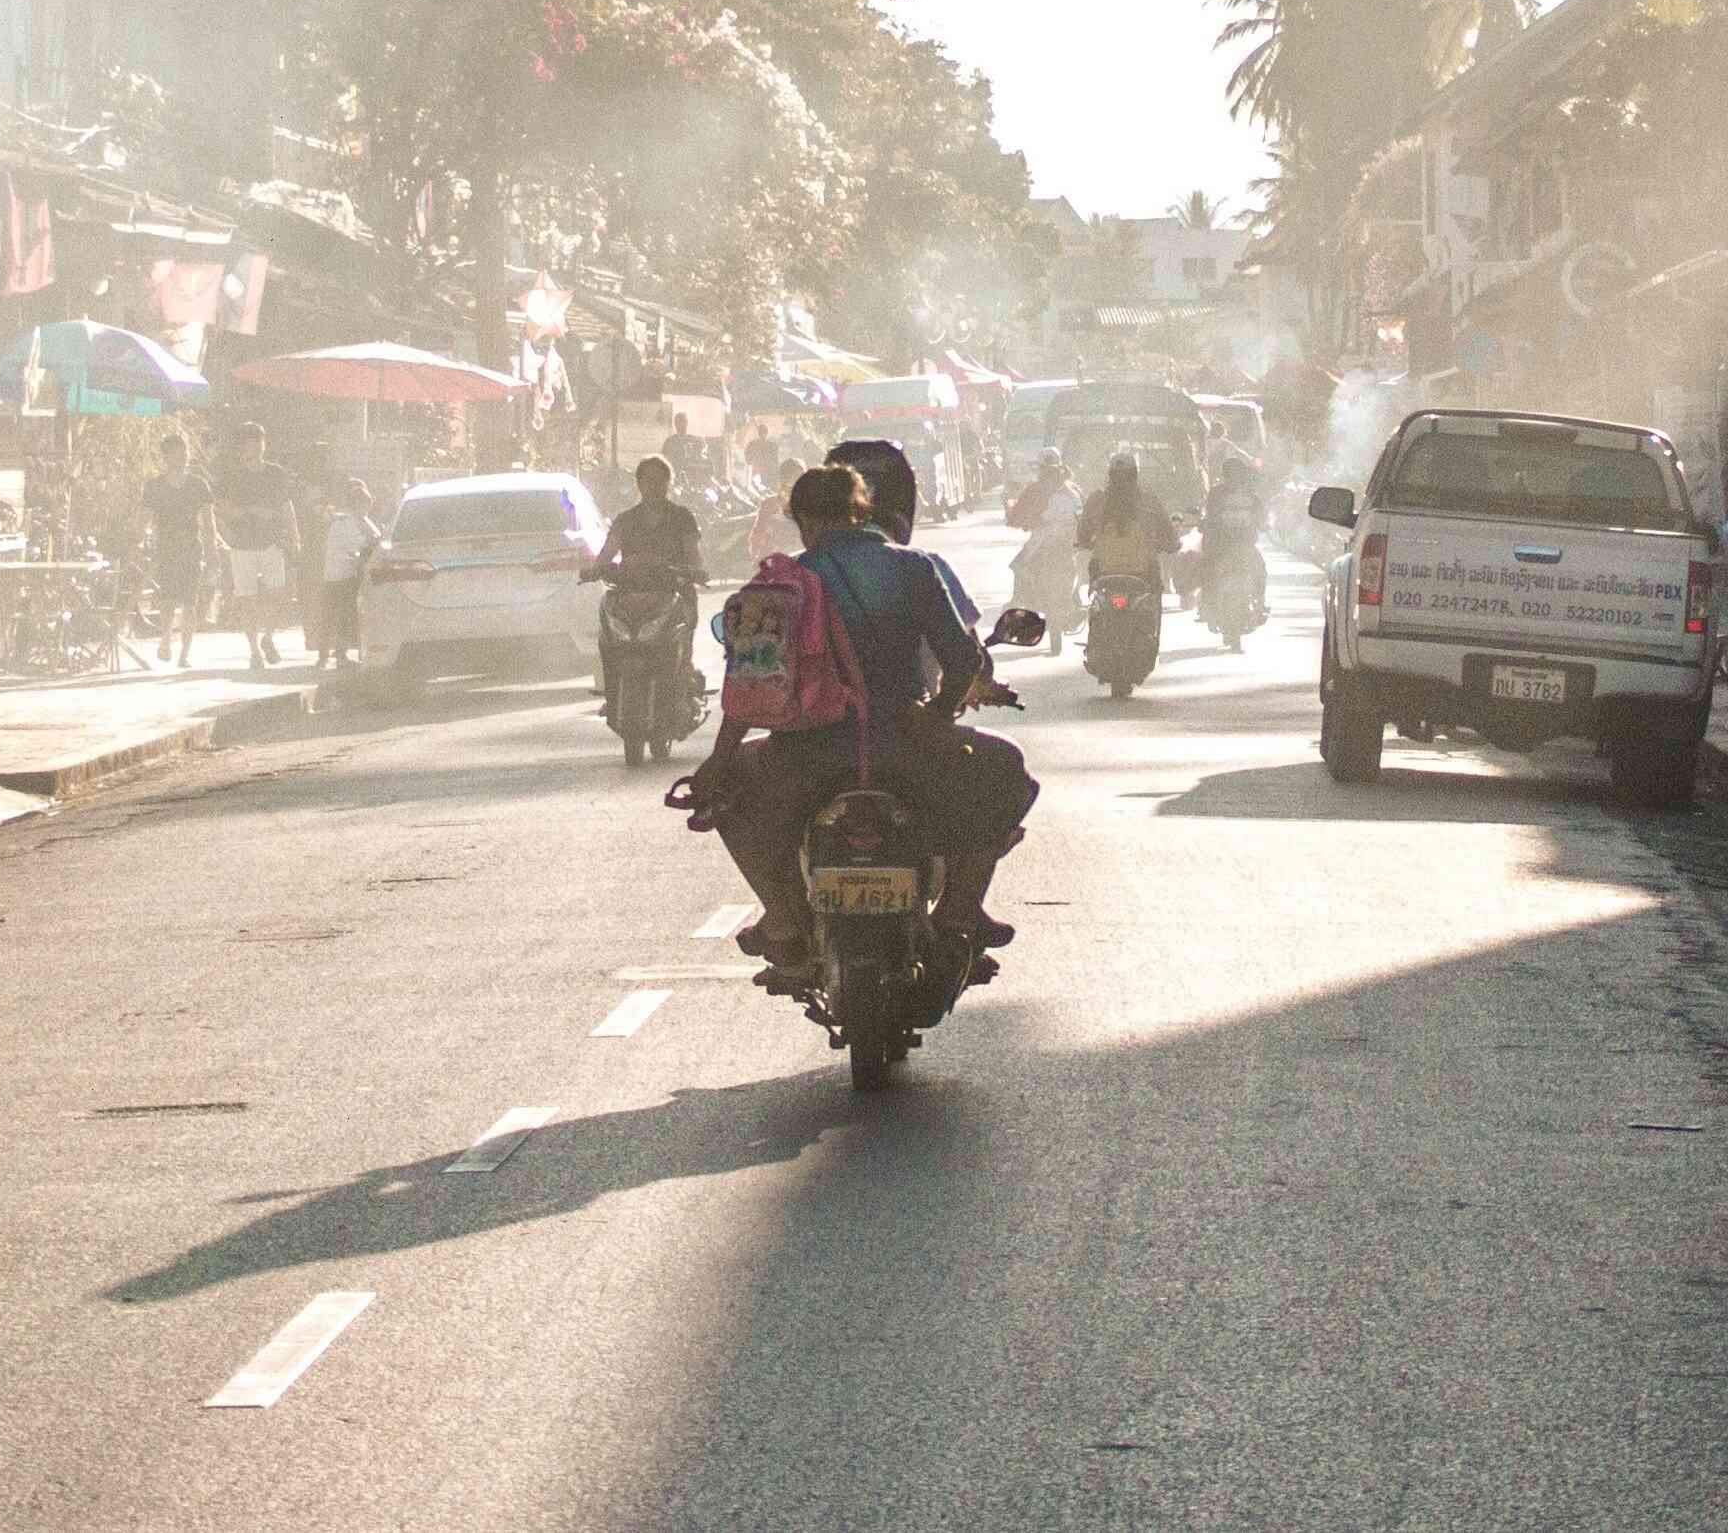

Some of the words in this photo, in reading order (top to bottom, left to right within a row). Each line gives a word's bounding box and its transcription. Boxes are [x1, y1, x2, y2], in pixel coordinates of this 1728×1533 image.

[1655, 583, 1683, 601] PBX
[1393, 590, 1422, 607] 020
[1521, 601, 1551, 617] 020
[1567, 605, 1643, 625] 52220102
[1522, 681, 1562, 700] 3782
